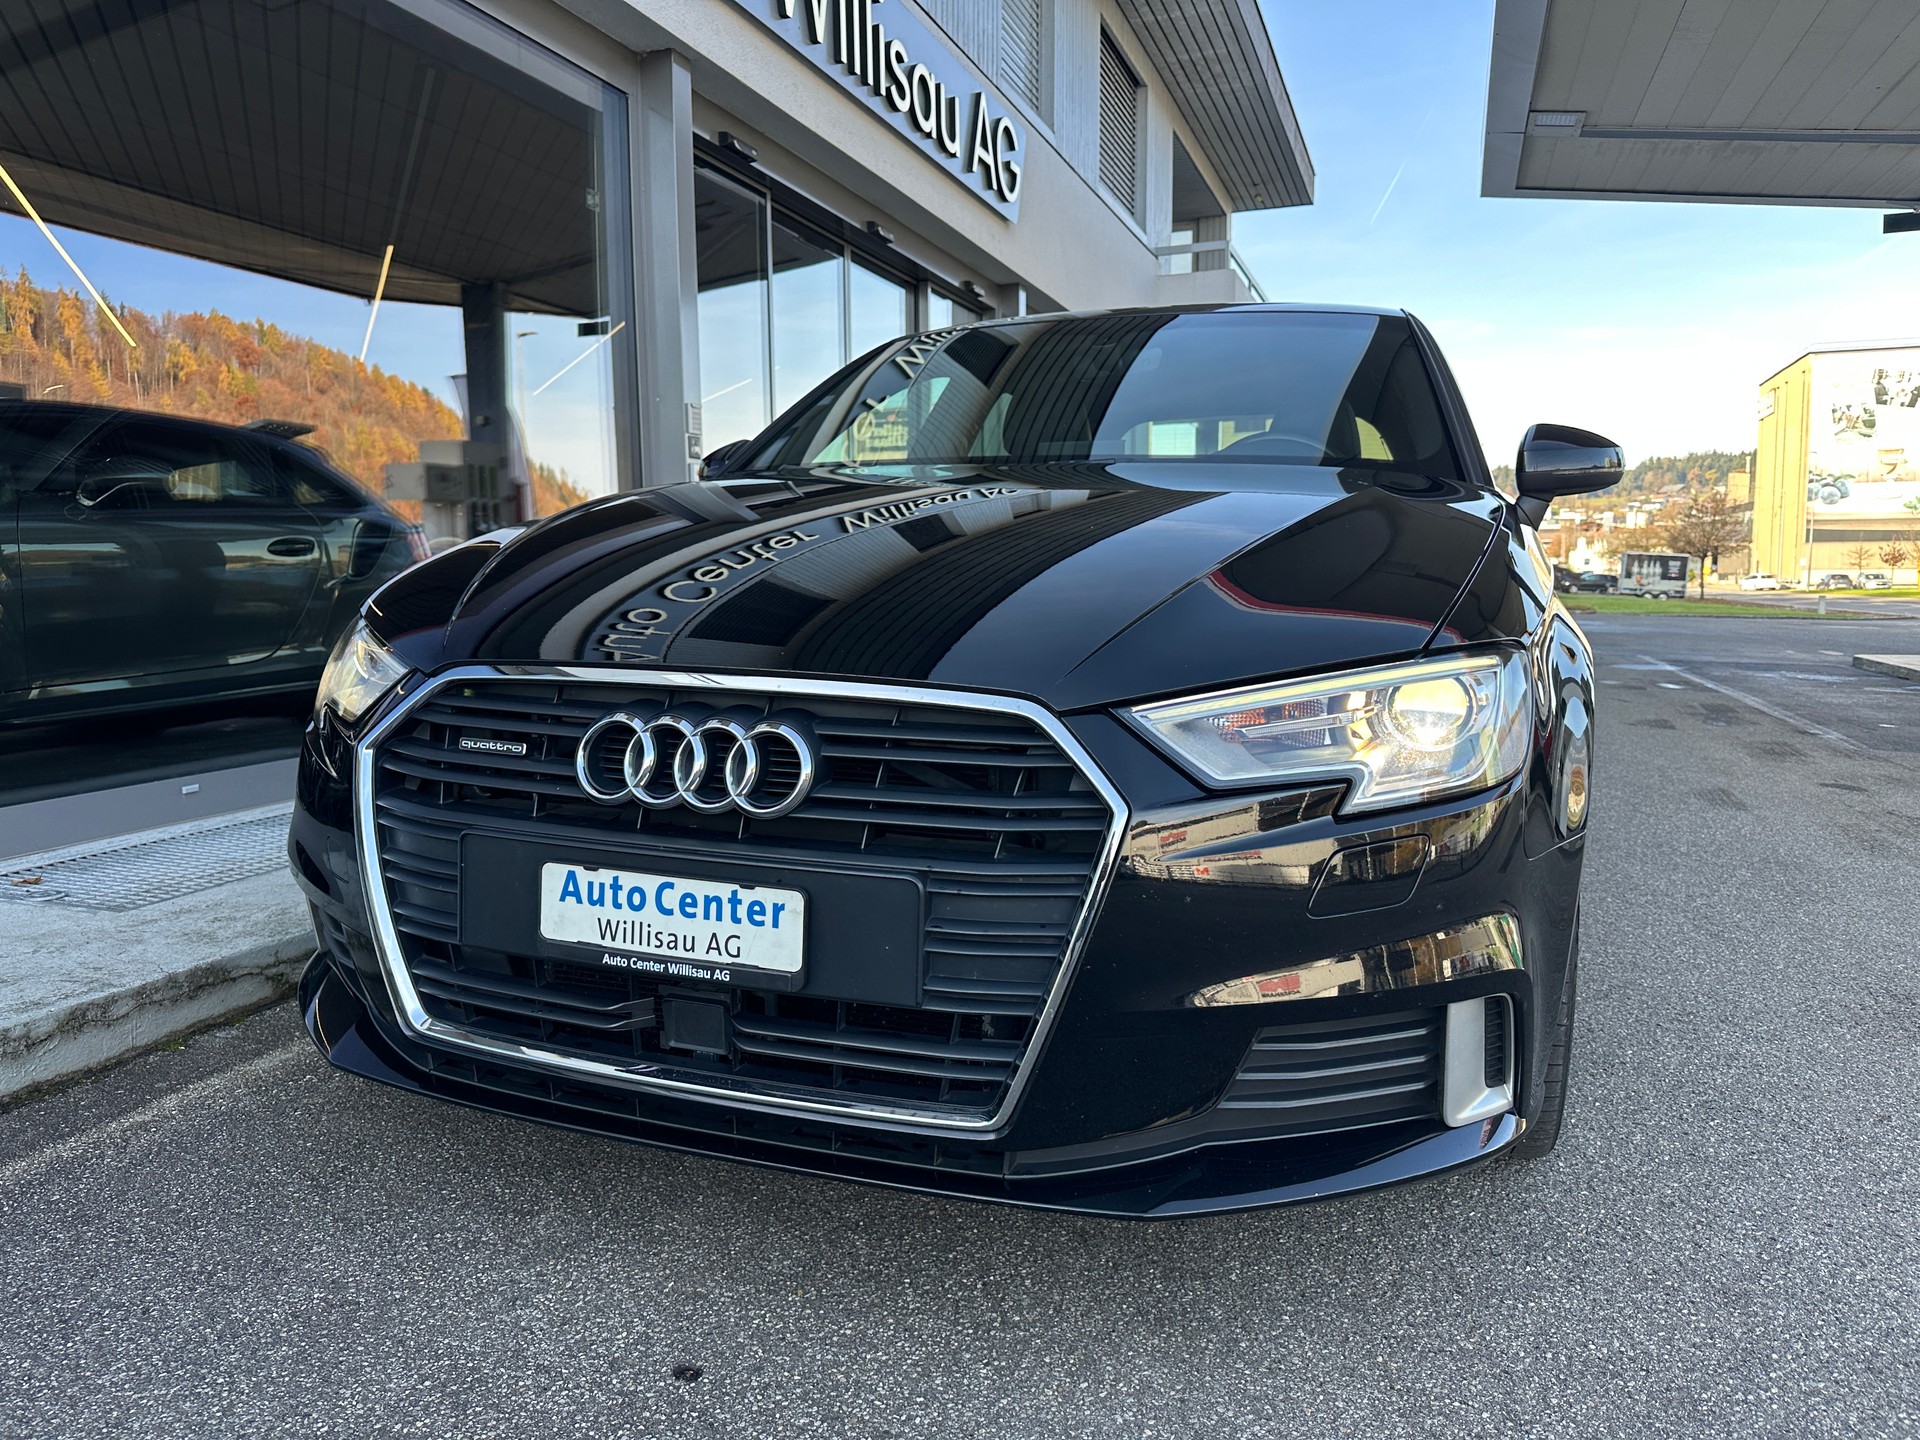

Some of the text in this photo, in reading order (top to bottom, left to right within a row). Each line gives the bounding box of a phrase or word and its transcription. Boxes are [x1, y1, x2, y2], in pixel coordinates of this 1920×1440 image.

[778, 0, 1020, 203] illisau AG
[461, 740, 523, 752] quattro
[597, 917, 741, 958] Willisau AG
[602, 953, 730, 981] Auto Center Willisau AG
